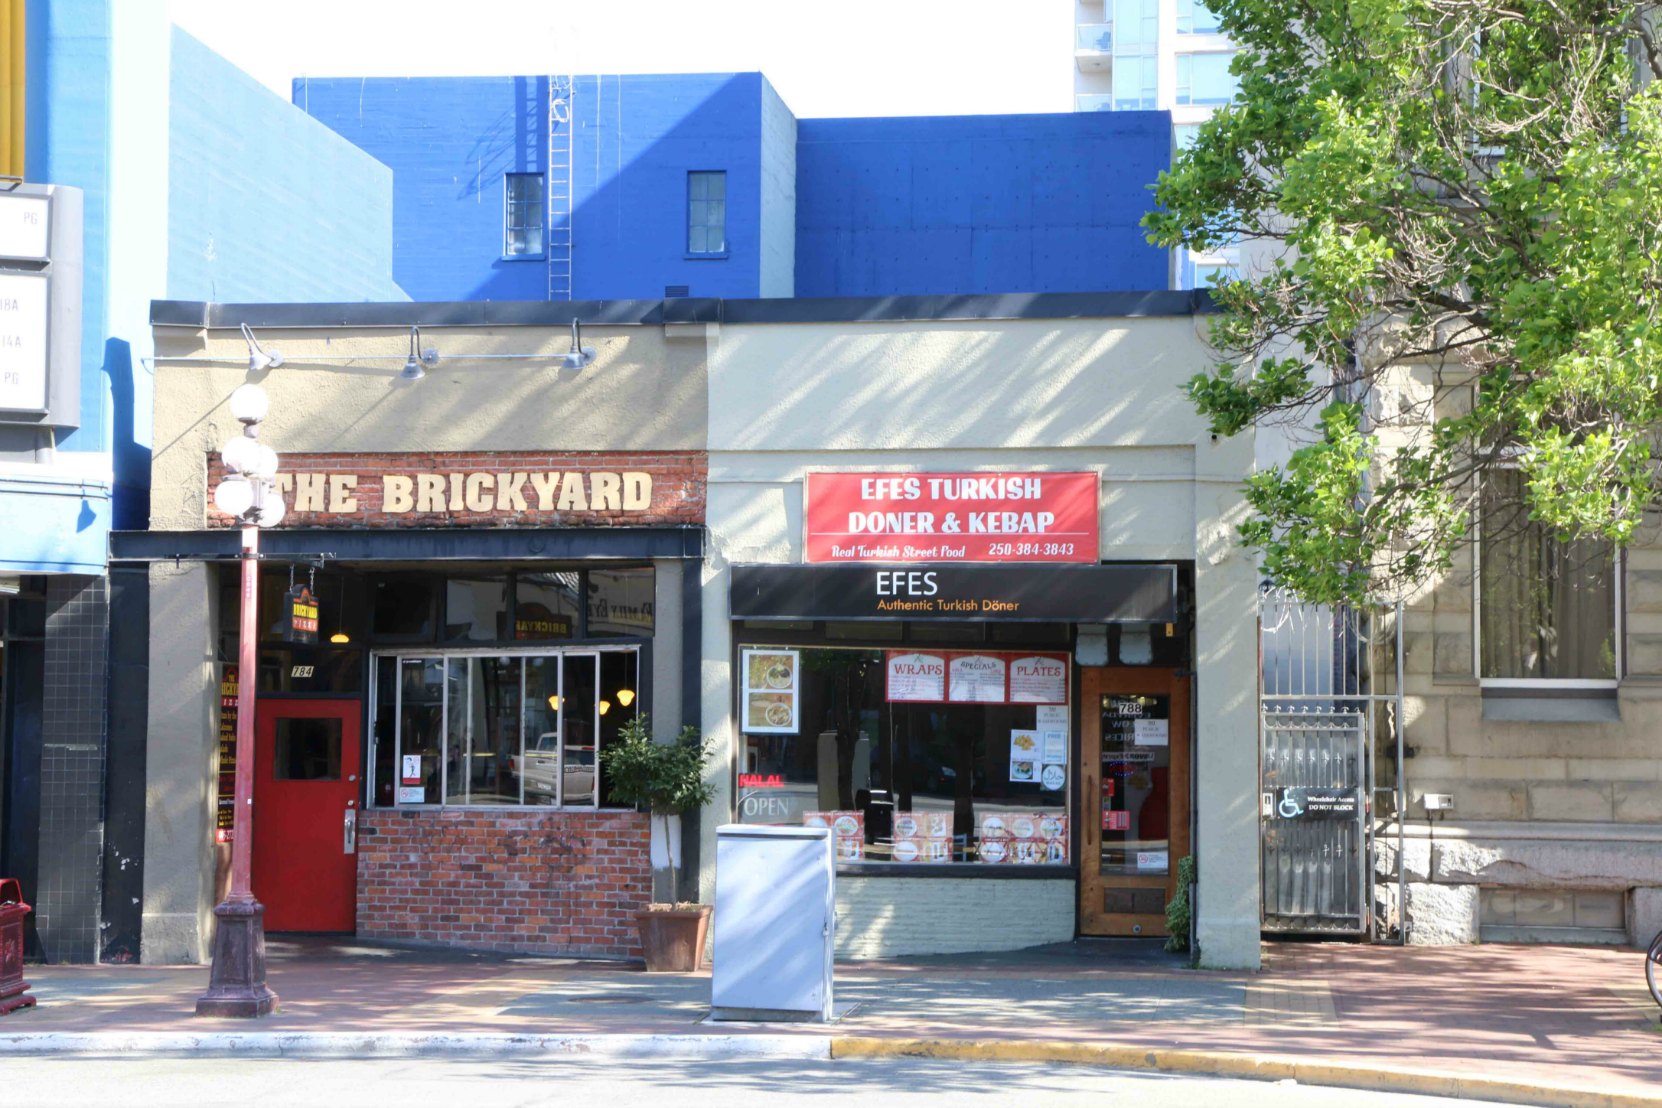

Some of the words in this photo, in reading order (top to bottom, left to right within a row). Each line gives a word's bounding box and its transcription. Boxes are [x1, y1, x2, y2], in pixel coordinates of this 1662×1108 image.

[382, 471, 653, 513] BRICKYARD
[861, 478, 921, 500] EFES
[927, 478, 1042, 500] TURKISH
[848, 511, 934, 533] DONER
[941, 511, 961, 533] &
[968, 511, 1055, 533] KEBAP
[831, 545, 856, 558] Real
[857, 544, 900, 558] Turkish
[902, 545, 938, 558] Street
[940, 545, 966, 558] Food
[988, 543, 1074, 556] 250-384-3843
[876, 571, 938, 596] EFES
[877, 599, 933, 611] Authentic
[937, 599, 978, 611] Turkish
[982, 599, 1019, 611] Döner
[293, 667, 313, 677] 784
[894, 664, 943, 675] WRAPS
[960, 661, 997, 670] SPECIALS
[1017, 666, 1061, 677] PLATES
[1120, 703, 1142, 713] 788
[738, 774, 785, 788] HALAL
[744, 797, 789, 816] OPEN
